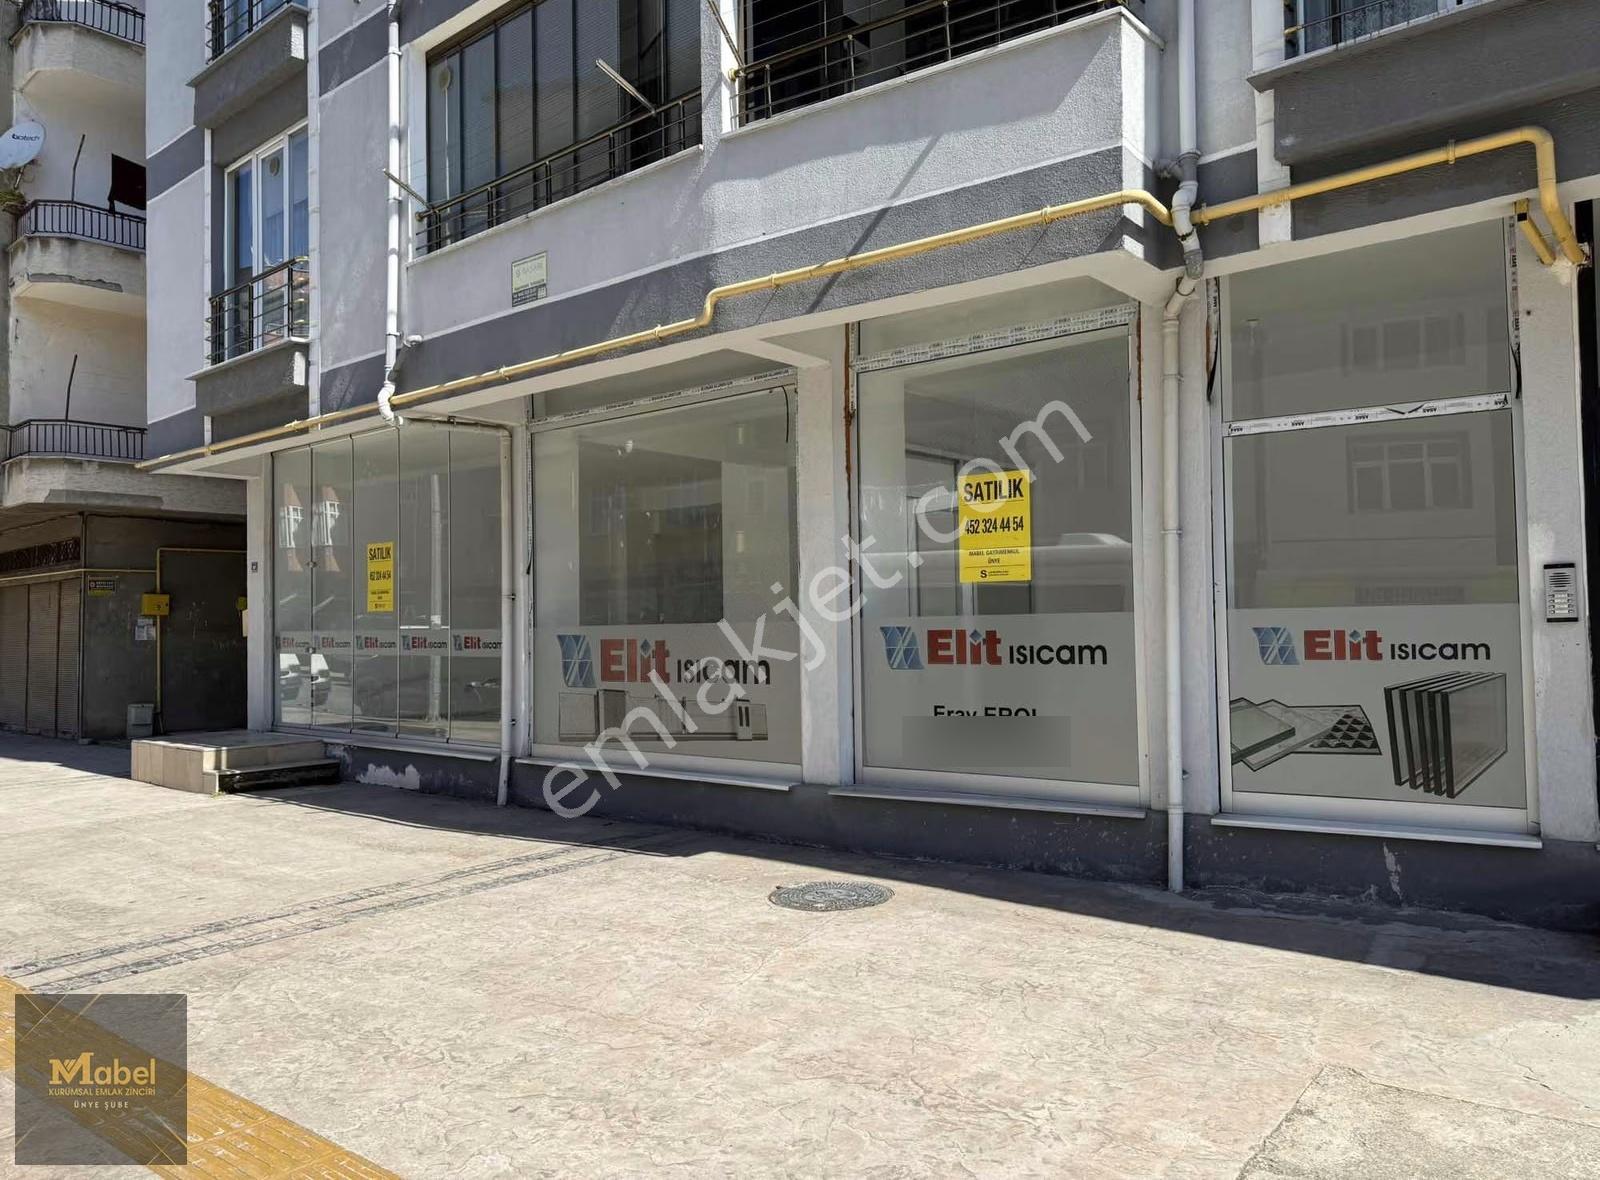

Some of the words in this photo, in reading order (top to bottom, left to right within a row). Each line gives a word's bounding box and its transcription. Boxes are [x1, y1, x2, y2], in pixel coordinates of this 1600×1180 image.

[964, 478, 1024, 502] SATILIK
[965, 519, 980, 535] 452
[982, 518, 998, 534] 324
[1000, 517, 1011, 532] 44
[1013, 516, 1024, 531] 54
[365, 636, 379, 649] Elit
[412, 636, 427, 649] Elit
[464, 636, 480, 649] Elit
[927, 629, 1002, 665] Elit
[1304, 630, 1383, 660] Elit
[601, 638, 671, 684] Elit
